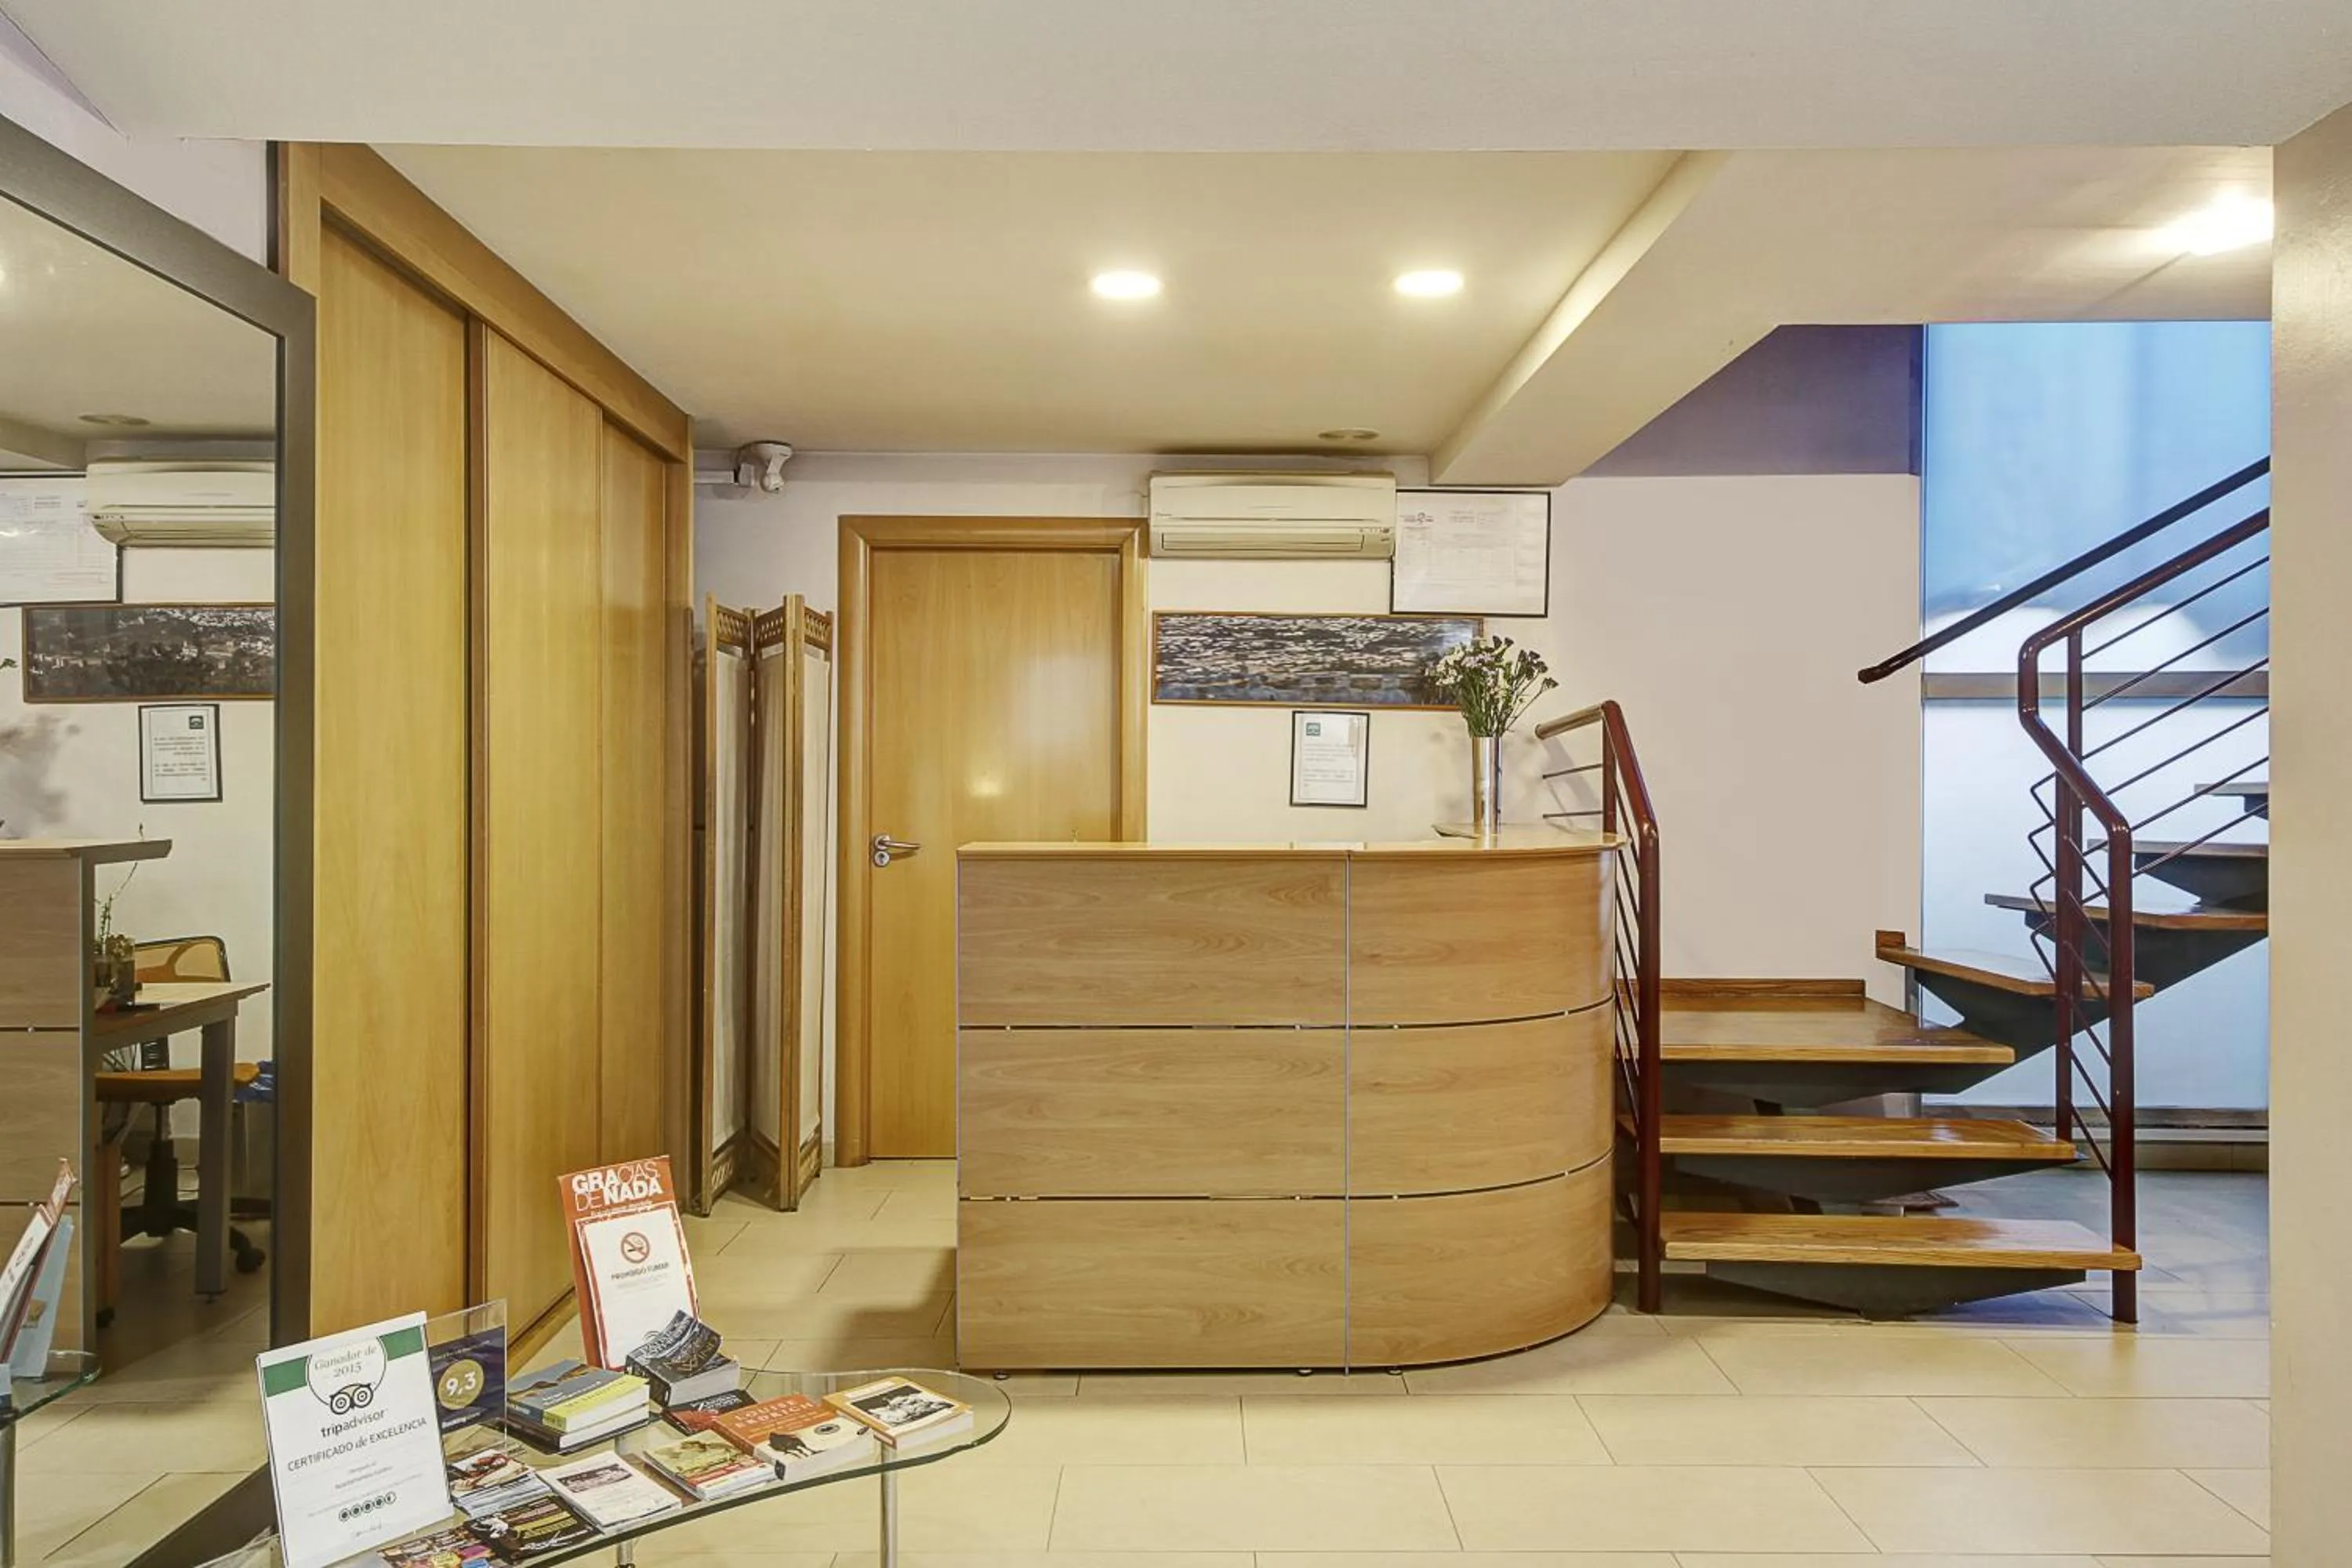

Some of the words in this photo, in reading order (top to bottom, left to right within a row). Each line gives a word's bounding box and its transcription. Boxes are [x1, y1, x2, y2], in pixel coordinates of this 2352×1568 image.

[575, 1190, 603, 1211] DE
[603, 1177, 663, 1205] NADA
[314, 1351, 361, 1370] Ganador
[364, 1345, 377, 1355] de
[333, 1363, 362, 1378] 2015
[446, 1371, 476, 1396] 9,3
[321, 1409, 385, 1438] tripadvisor
[288, 1442, 353, 1472] CERTIFICADO
[355, 1436, 368, 1449] de
[369, 1417, 427, 1443] EXCELENCIA
